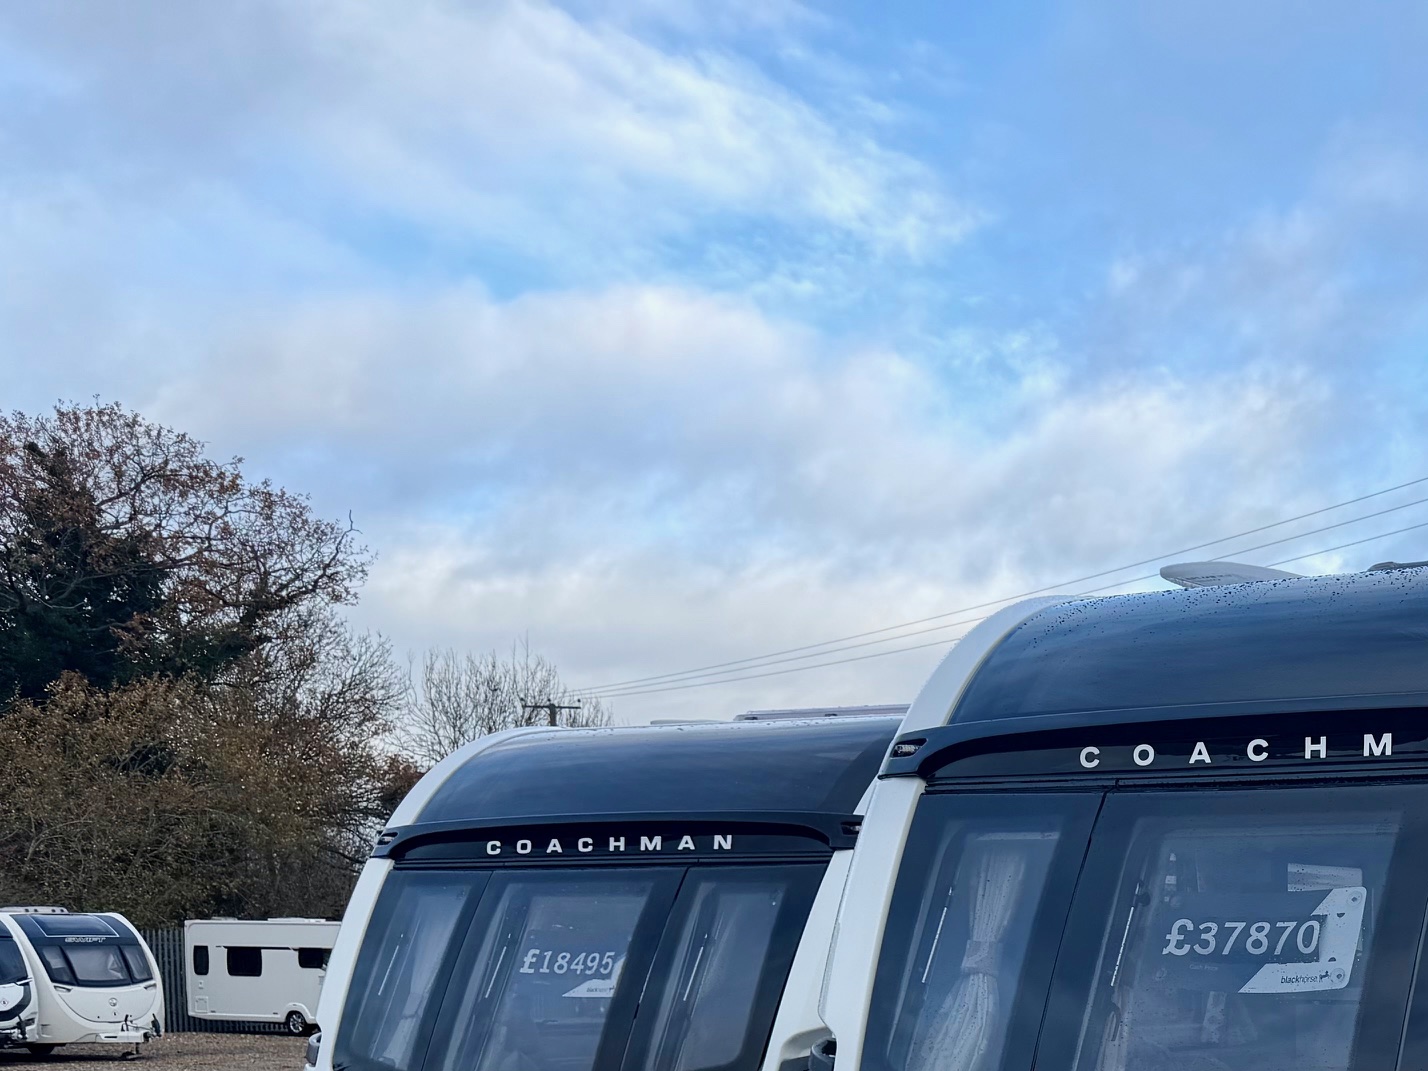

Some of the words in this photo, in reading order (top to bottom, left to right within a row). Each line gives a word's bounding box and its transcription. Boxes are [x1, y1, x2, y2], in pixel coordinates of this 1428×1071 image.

[486, 834, 733, 855] COACHMAN
[1162, 918, 1320, 957] £37870
[519, 948, 615, 975] £18495
